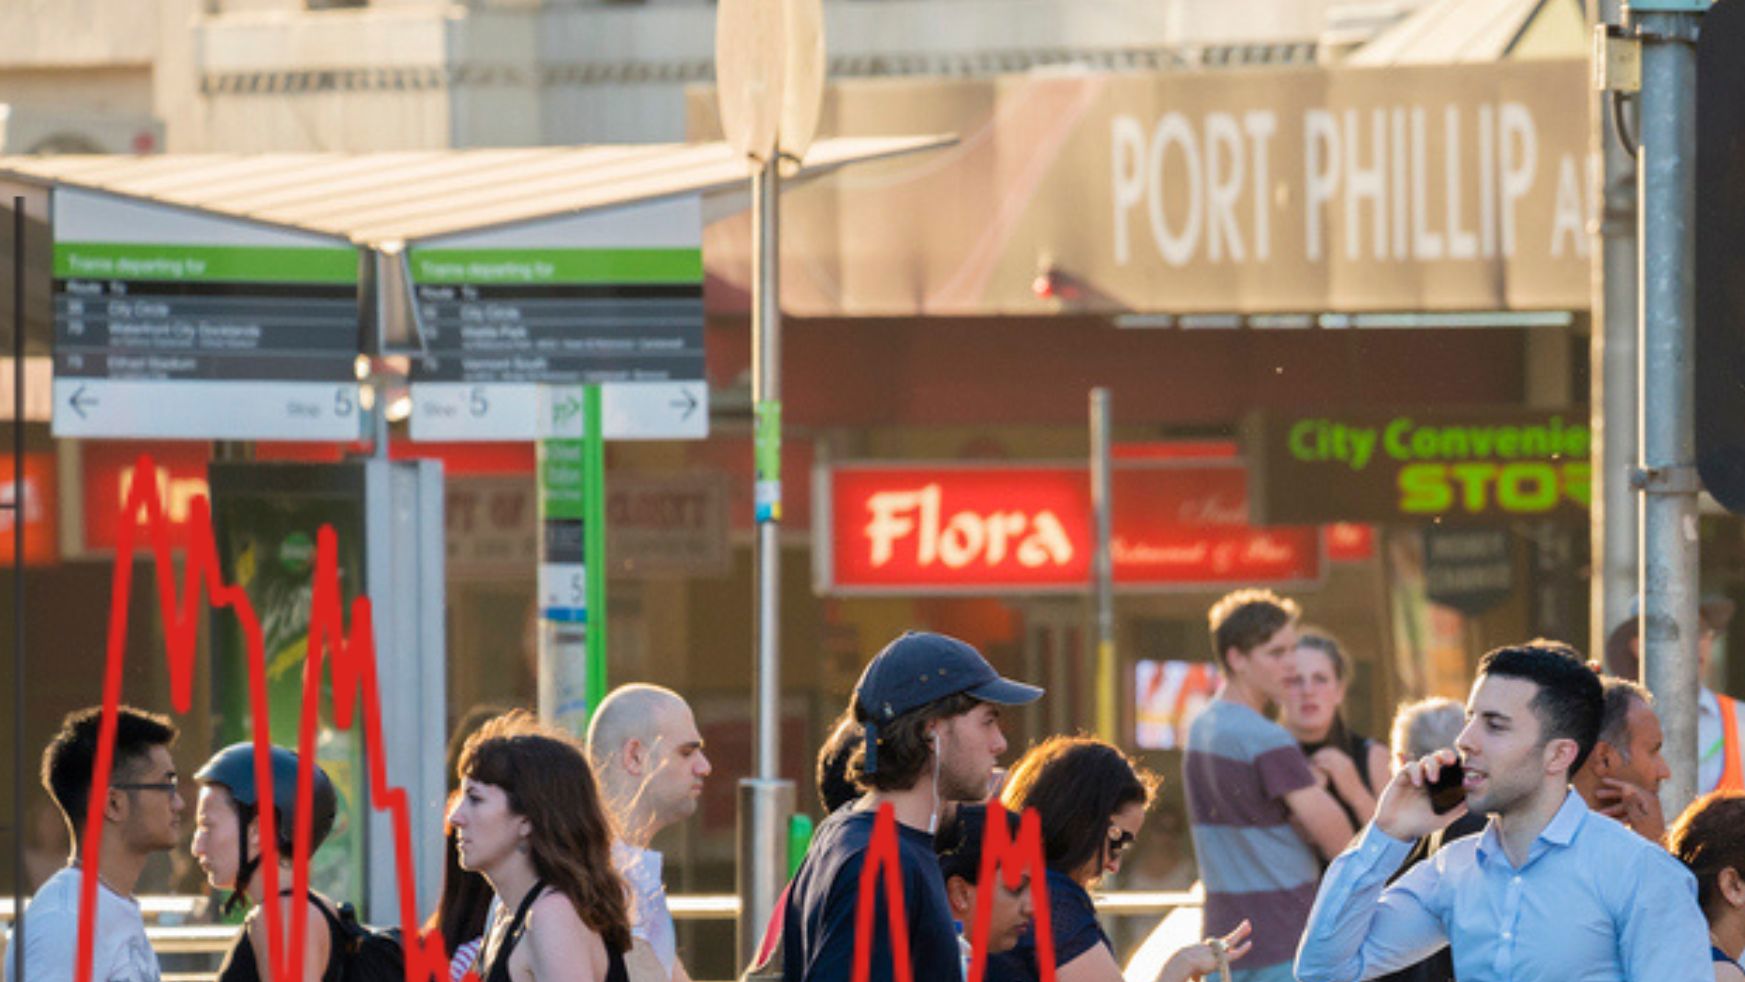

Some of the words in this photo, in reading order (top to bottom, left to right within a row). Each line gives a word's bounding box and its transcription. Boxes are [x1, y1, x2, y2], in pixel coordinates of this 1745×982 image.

[1111, 109, 1278, 267] PORT
[1305, 101, 1537, 263] PHILLIP
[334, 387, 353, 417] 5
[469, 387, 488, 417] 5
[1288, 418, 1377, 471] City
[865, 483, 1074, 569] Flora
